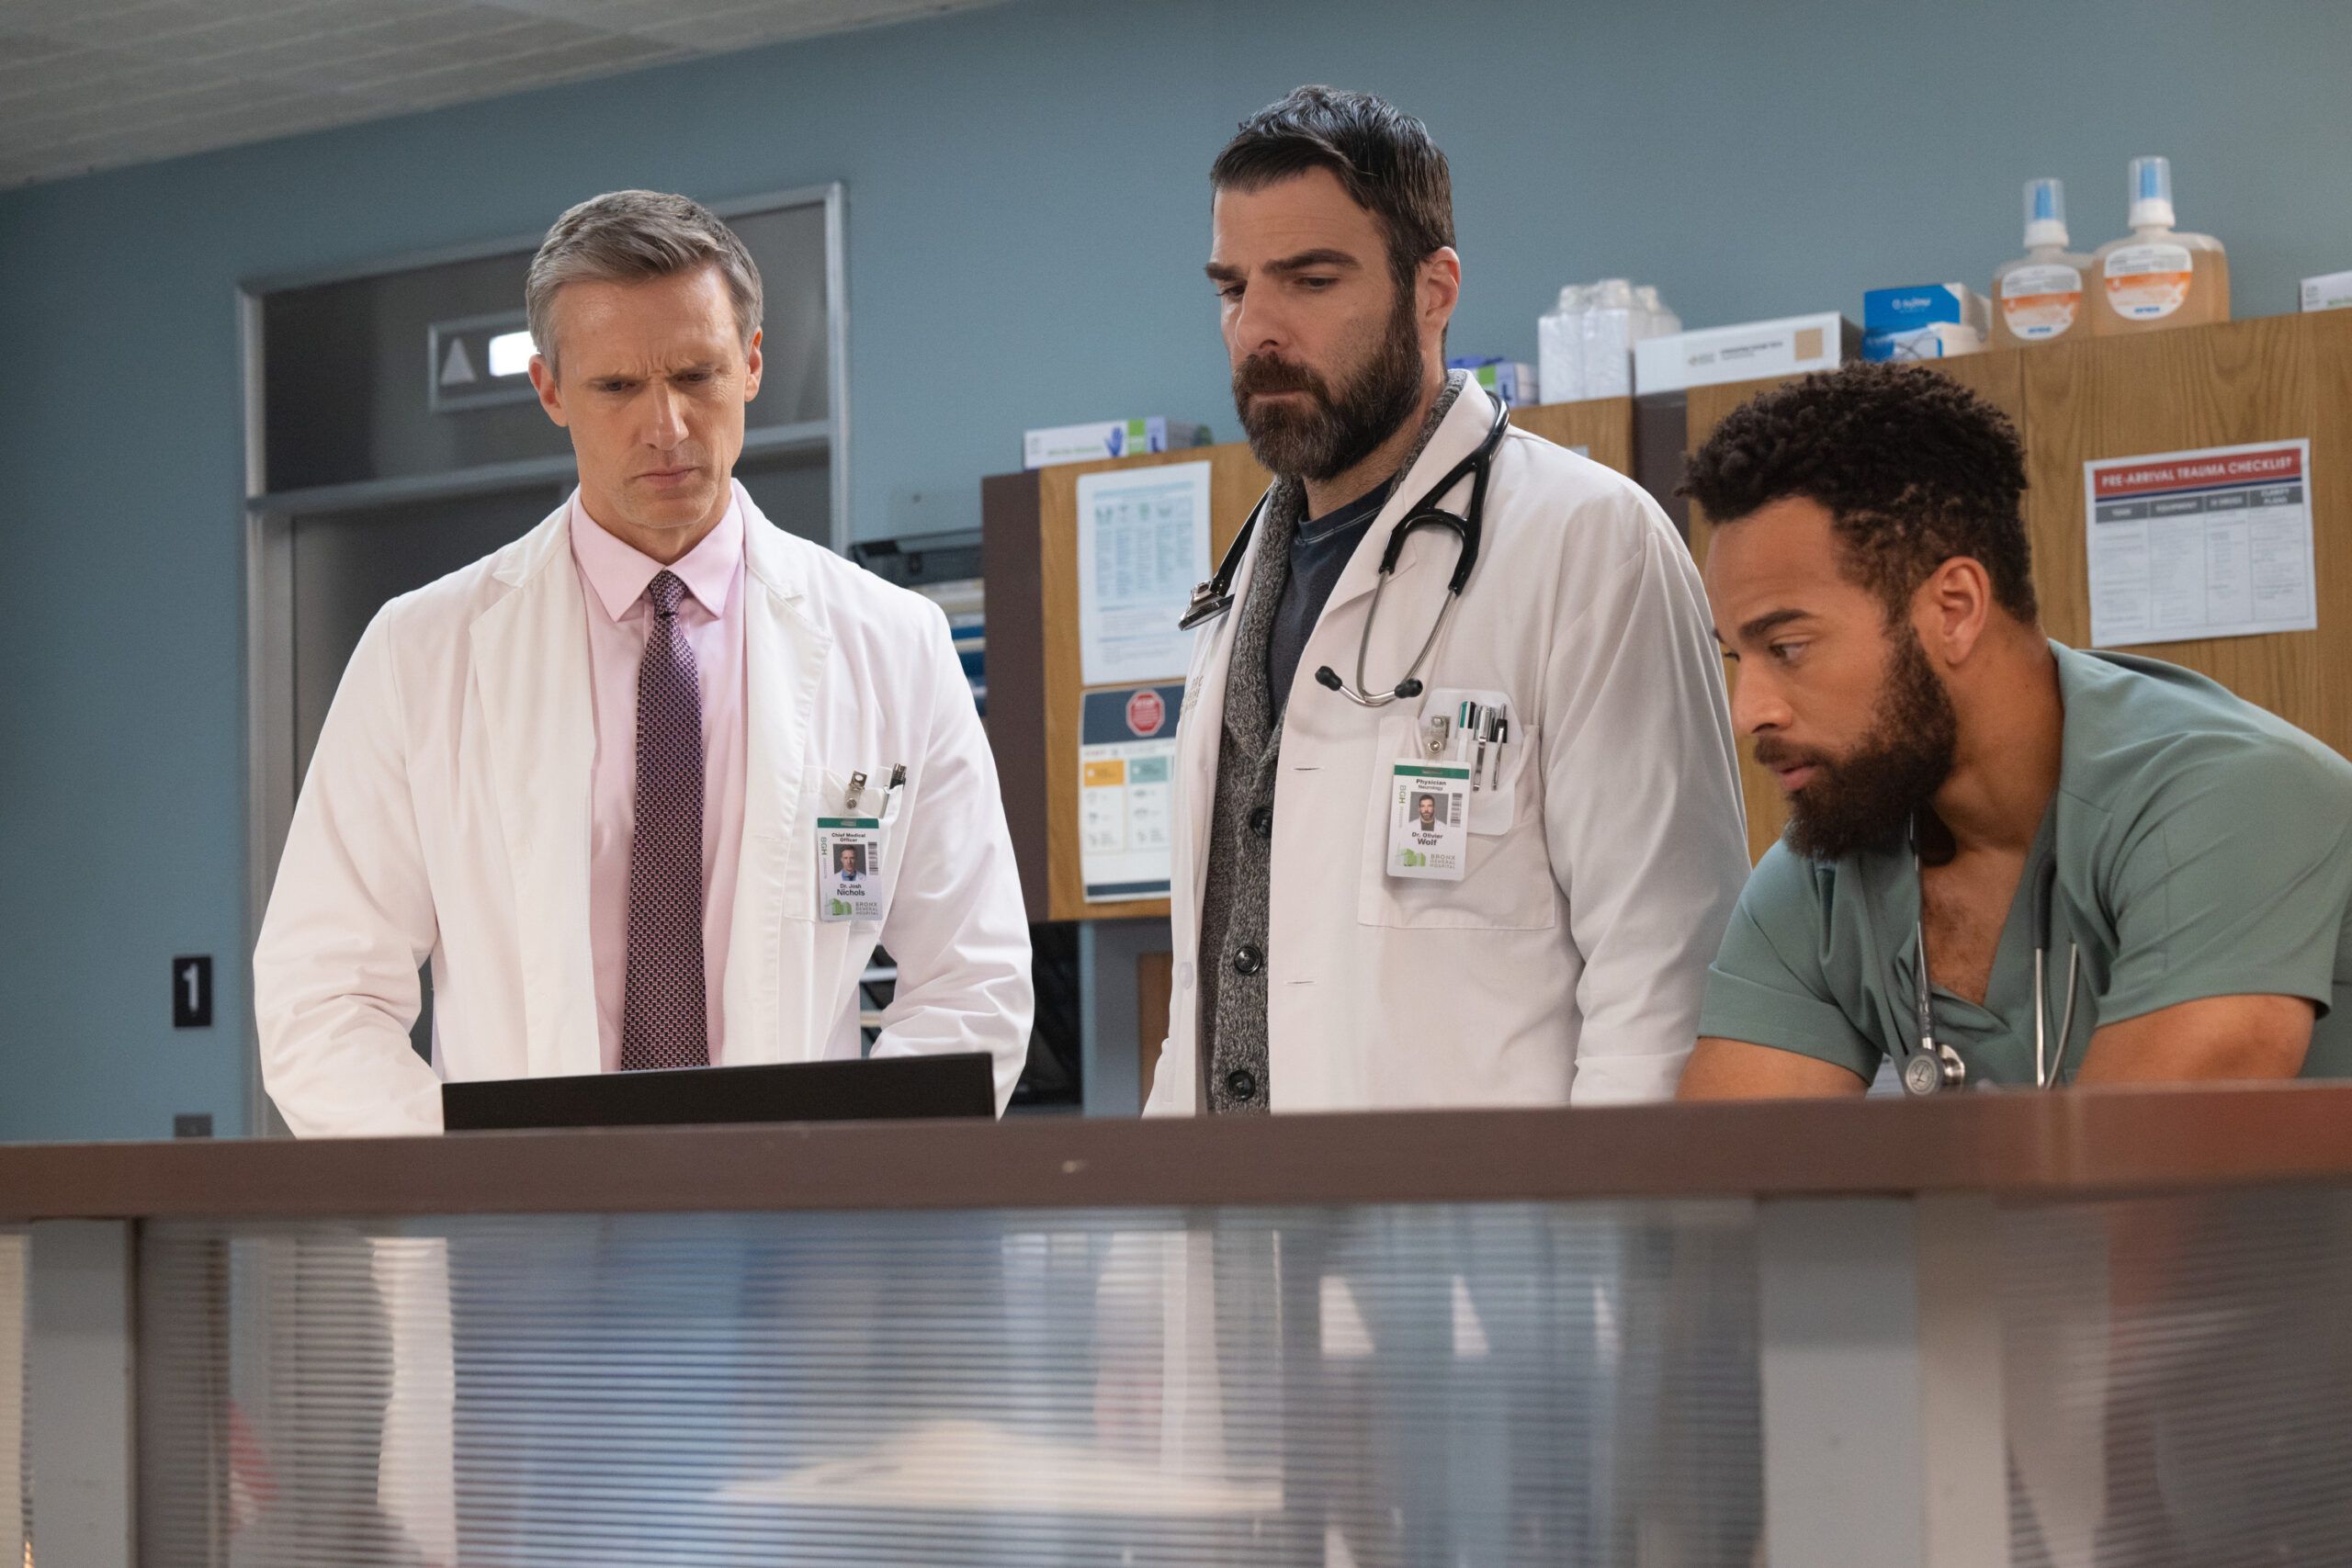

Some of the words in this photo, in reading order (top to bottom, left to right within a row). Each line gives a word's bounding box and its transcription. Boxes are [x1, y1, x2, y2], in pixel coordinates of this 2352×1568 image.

[2101, 469, 2175, 488] PRE-ARRIVAL
[2177, 463, 2225, 479] TRAUMA
[2228, 456, 2292, 475] CHECKLIST
[1418, 838, 1438, 846] Wolf
[837, 888, 865, 897] Nichols
[182, 963, 199, 1012] 1
